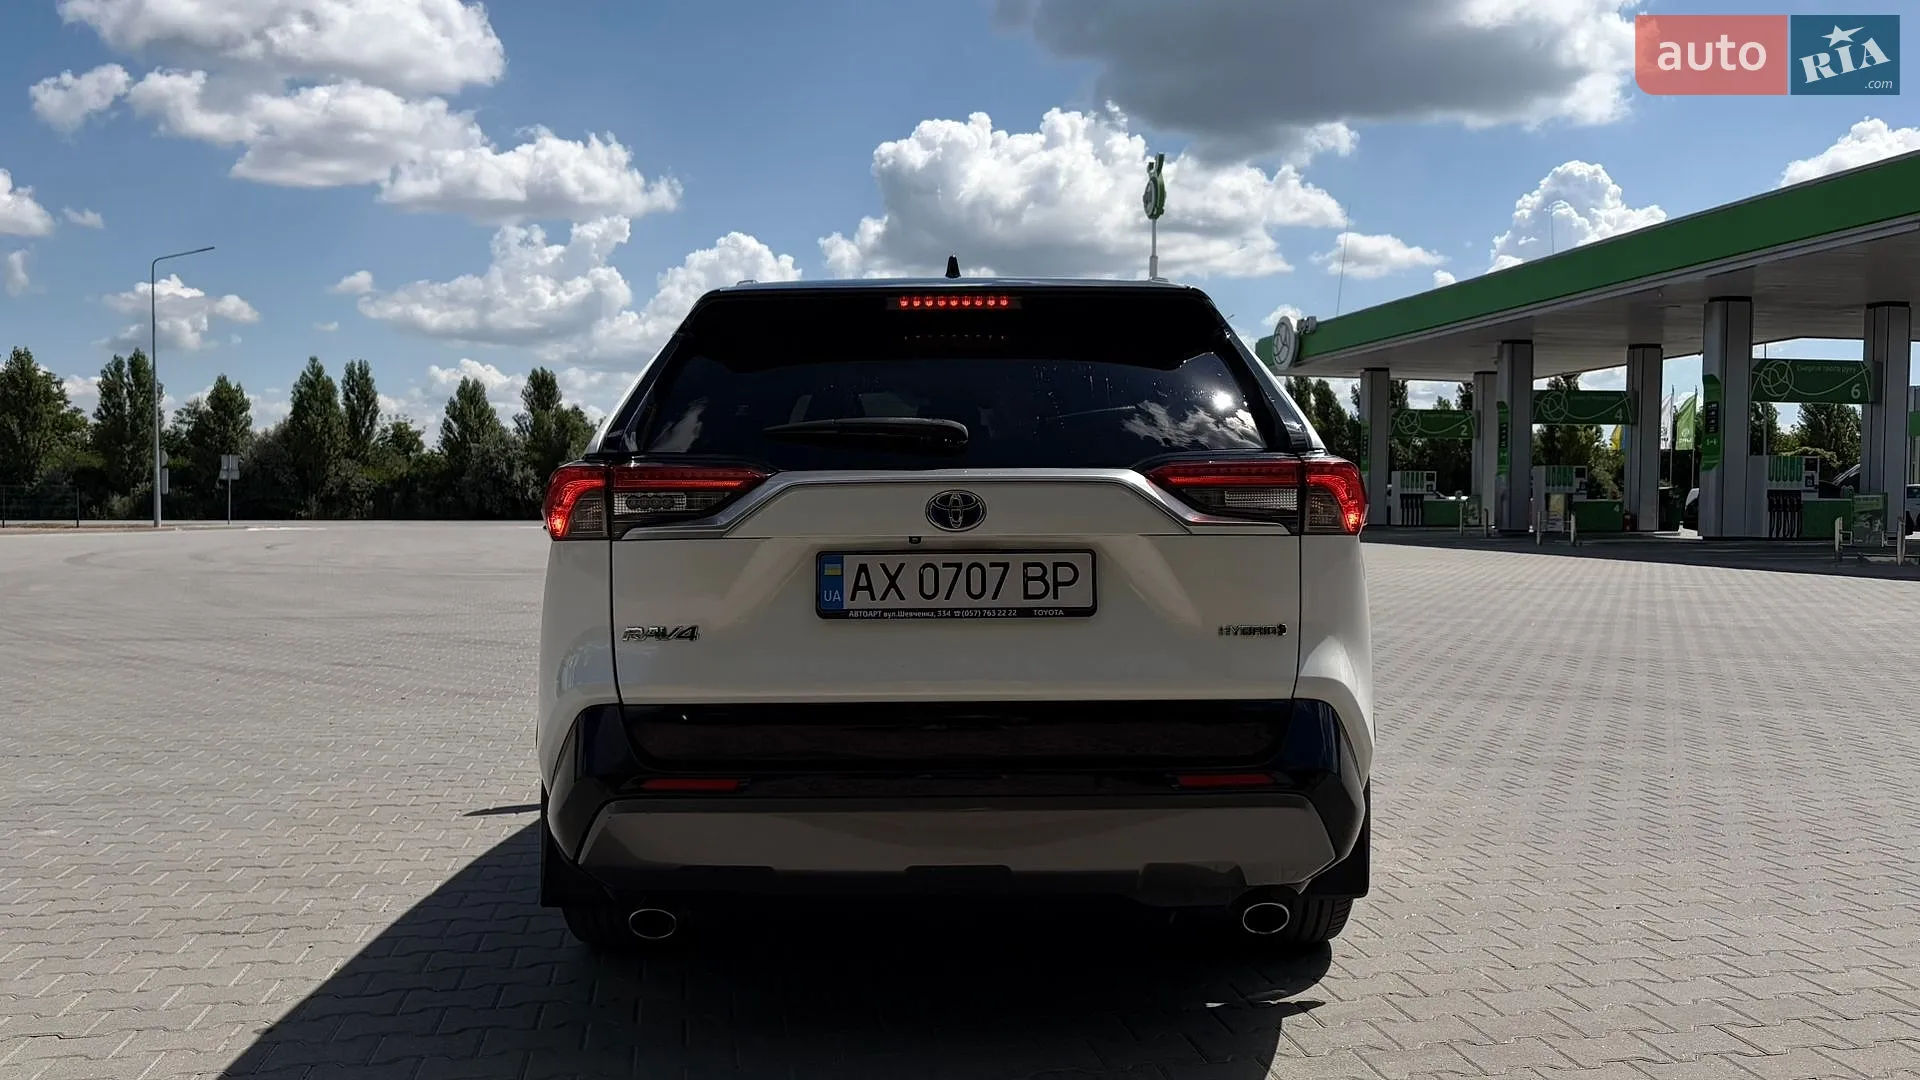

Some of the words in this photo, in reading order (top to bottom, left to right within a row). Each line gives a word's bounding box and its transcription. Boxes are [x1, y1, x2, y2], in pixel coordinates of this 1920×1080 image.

[1850, 383, 1861, 399] 6
[1614, 408, 1624, 422] 4
[1460, 424, 1469, 436] 2
[849, 561, 907, 602] AX
[918, 561, 1010, 601] 0707
[1022, 561, 1080, 601] BP
[823, 590, 841, 602] UA
[1033, 609, 1065, 617] TOYOTA
[622, 625, 699, 641] RAV4
[1217, 624, 1277, 636] HYBRID
